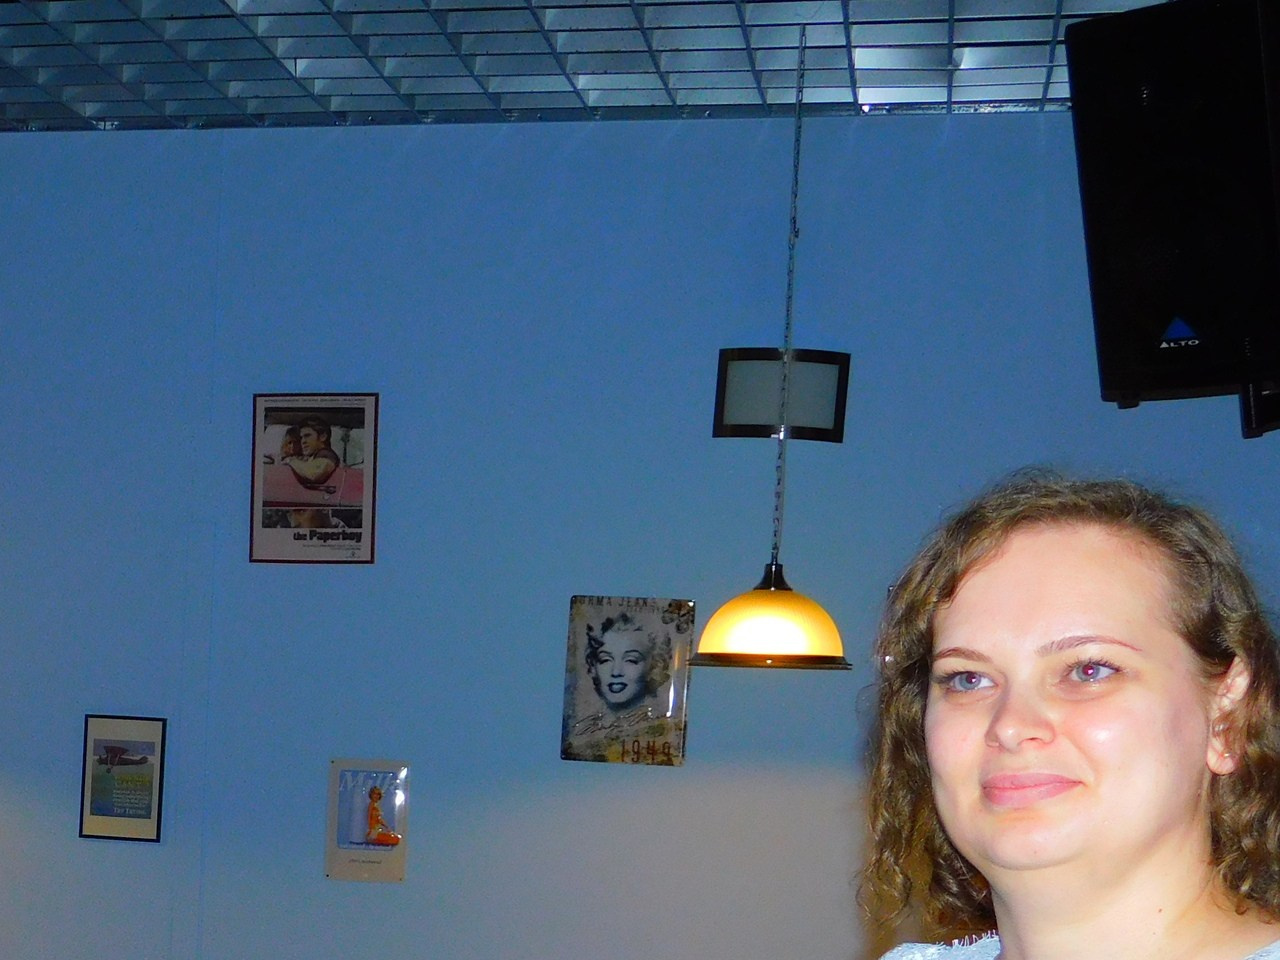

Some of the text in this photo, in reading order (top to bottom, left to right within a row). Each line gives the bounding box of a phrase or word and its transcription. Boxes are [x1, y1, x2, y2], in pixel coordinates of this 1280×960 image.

[1159, 339, 1200, 348] ALTO
[293, 530, 362, 543] the Paperboy
